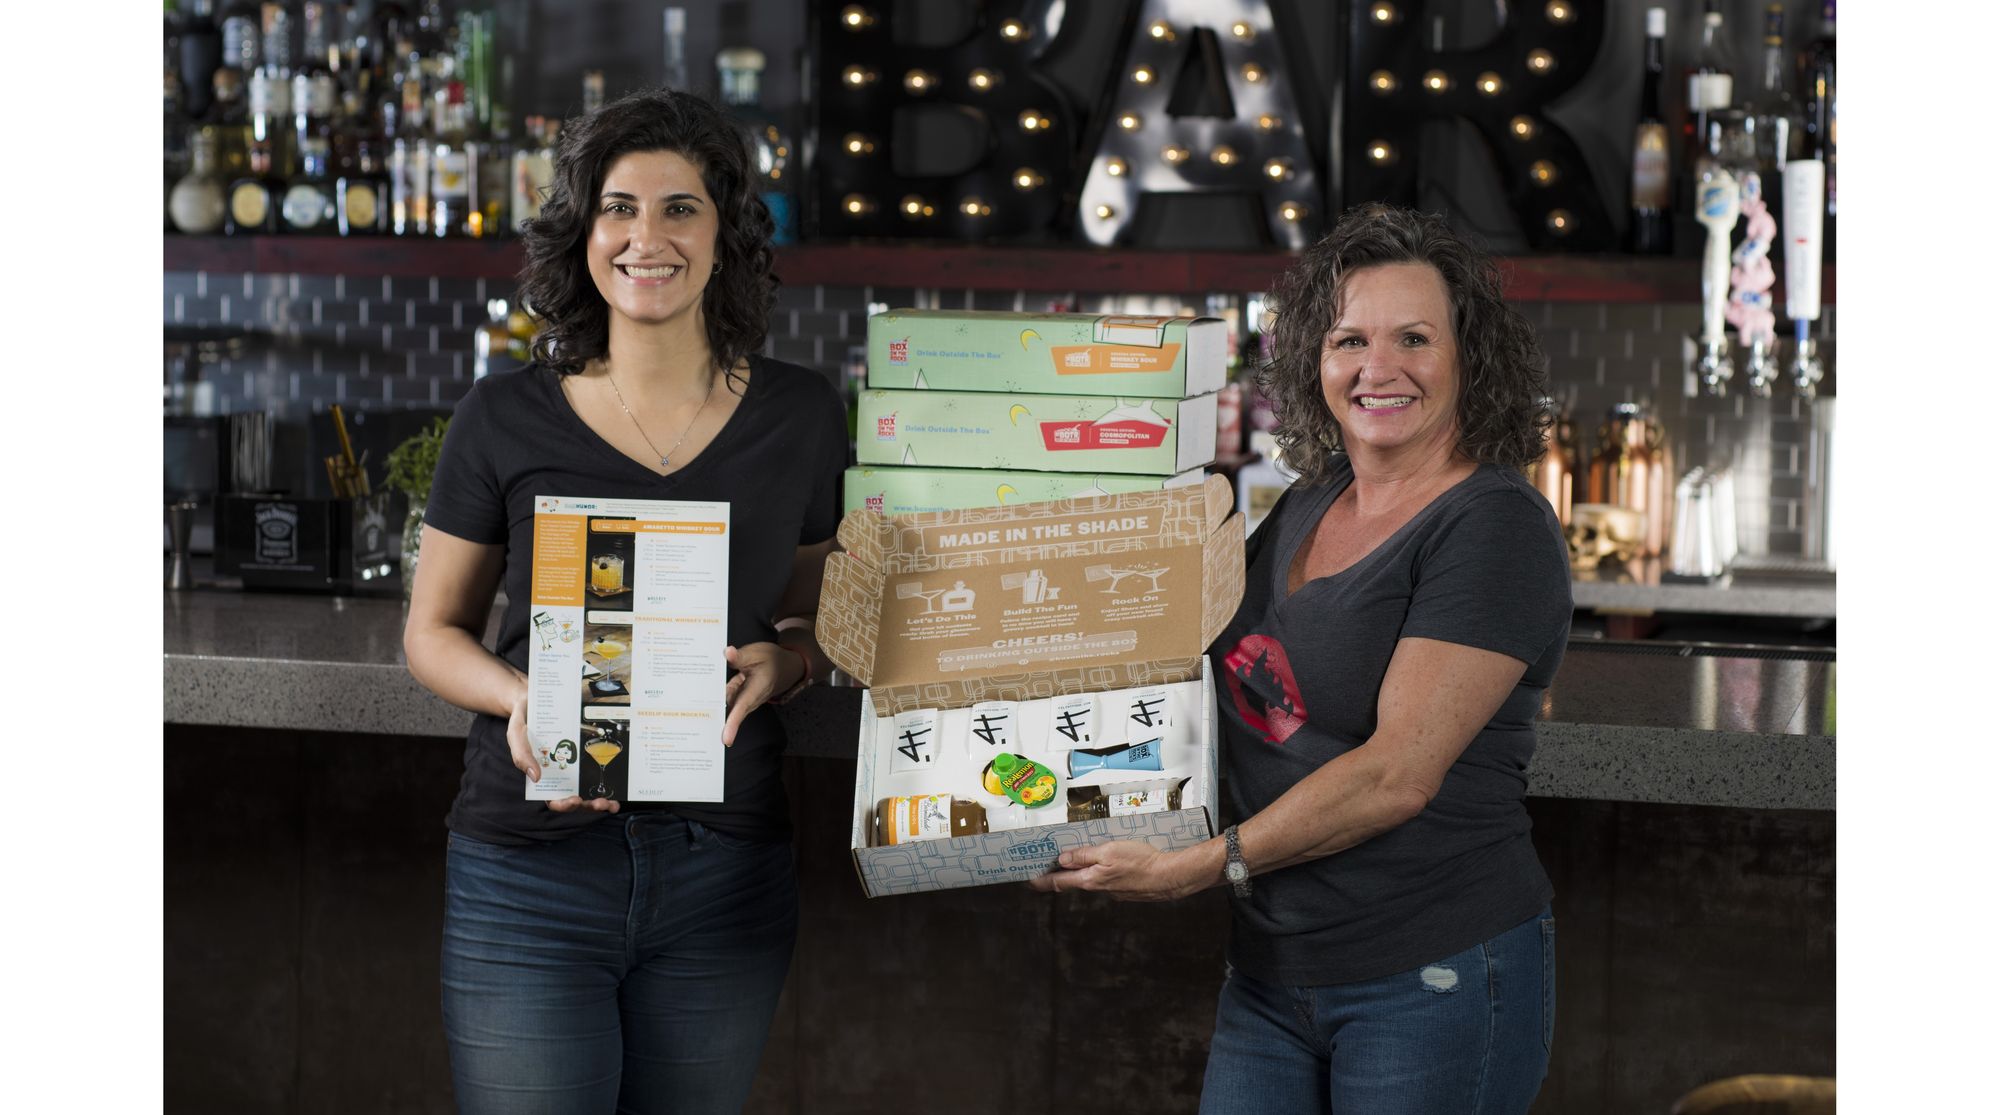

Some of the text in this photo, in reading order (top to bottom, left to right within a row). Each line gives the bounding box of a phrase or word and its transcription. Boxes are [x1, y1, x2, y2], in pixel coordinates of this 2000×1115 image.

[810, 0, 1612, 254] BAR
[889, 343, 907, 351] BOX
[916, 349, 939, 357] Drink
[939, 350, 969, 358] Outside
[878, 418, 896, 426] BOX
[905, 424, 990, 435] Drink Outside The Box
[1099, 432, 1150, 440] COSMOPOLITAN
[866, 497, 884, 505] BOX
[939, 516, 1149, 549] MADE IN THE SHADE
[1111, 595, 1160, 606] Rock On
[1003, 608, 1032, 617] Build
[1034, 606, 1055, 614] The
[906, 612, 977, 625] Let's Do This
[992, 631, 1084, 649] CHEERS!
[936, 637, 1139, 664] TO DRINKING OUTSIDE THE BOX
[977, 867, 1007, 876] Drink
[1008, 862, 1050, 872] Outside
